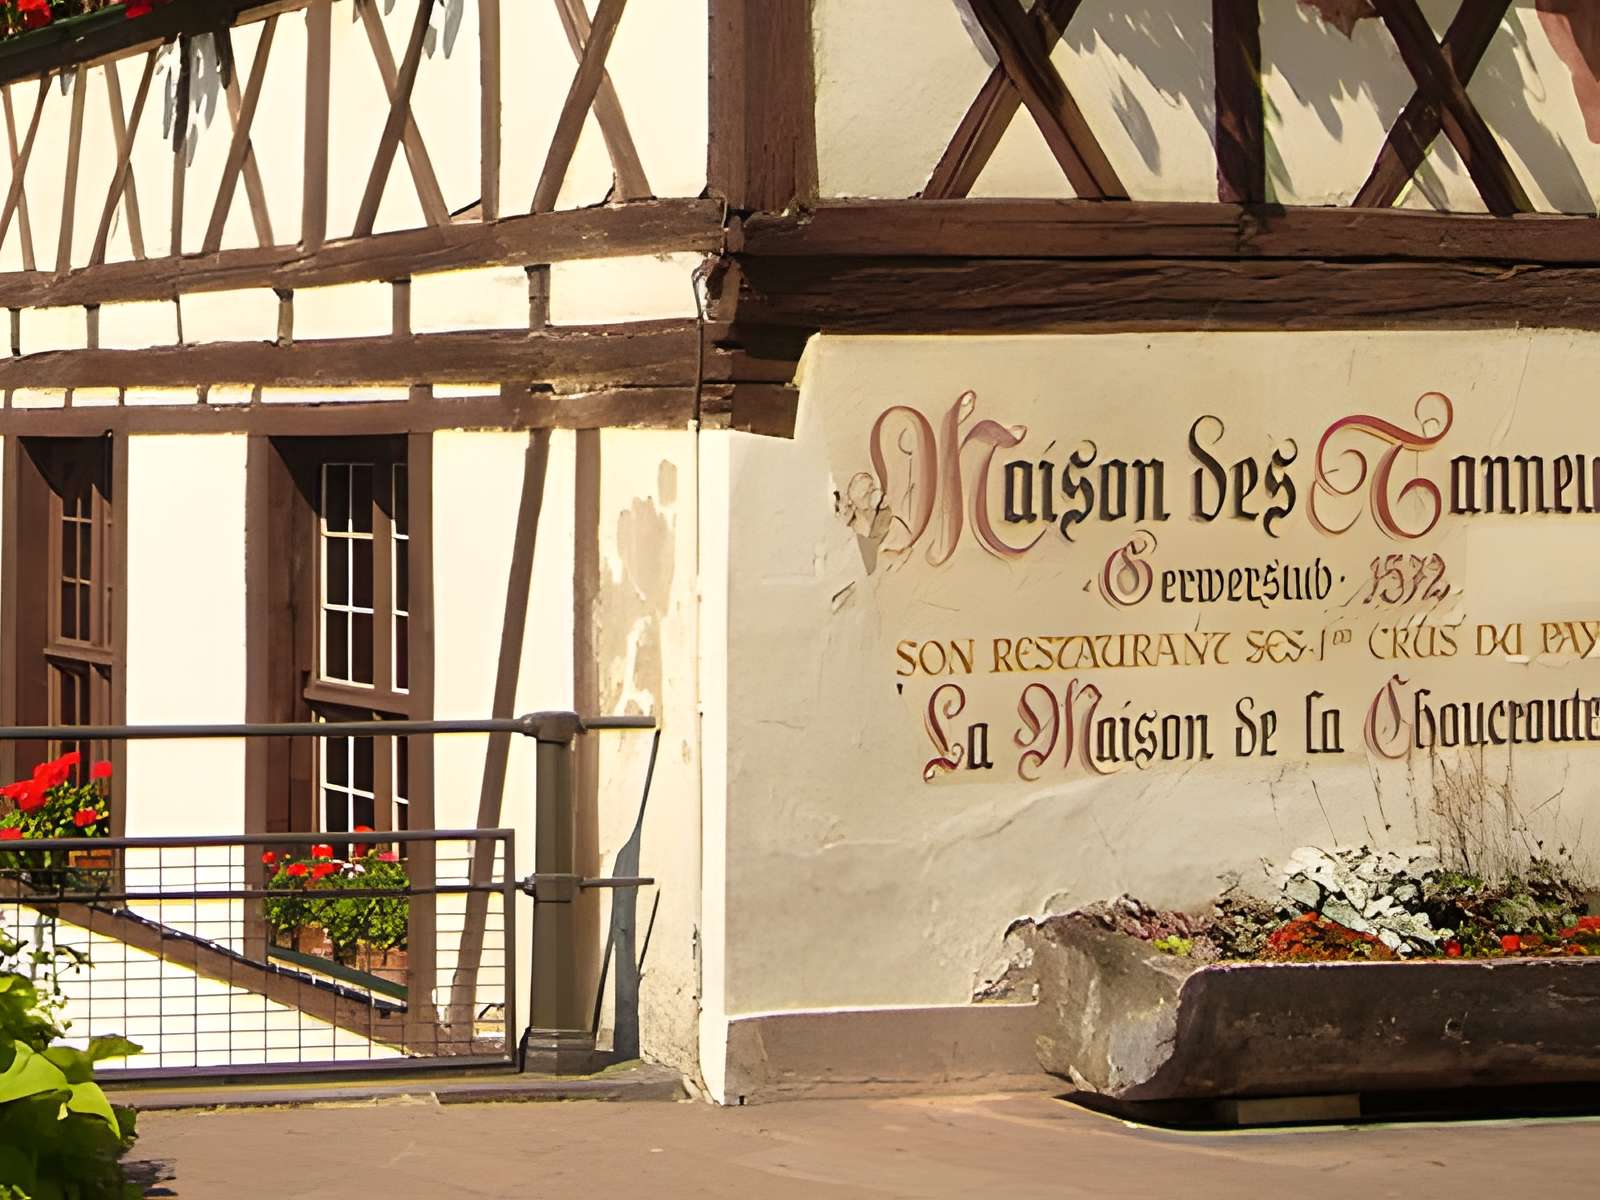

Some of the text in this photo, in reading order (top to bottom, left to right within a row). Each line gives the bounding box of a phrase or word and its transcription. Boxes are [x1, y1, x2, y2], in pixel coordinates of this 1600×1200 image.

[868, 389, 1169, 567] Maison
[1188, 414, 1298, 538] des
[895, 638, 975, 676] SON
[990, 631, 1232, 673] RESTAURANT
[923, 683, 994, 782] La
[1013, 678, 1214, 782] Maison
[1235, 696, 1278, 757] de
[1305, 690, 1344, 753] la
